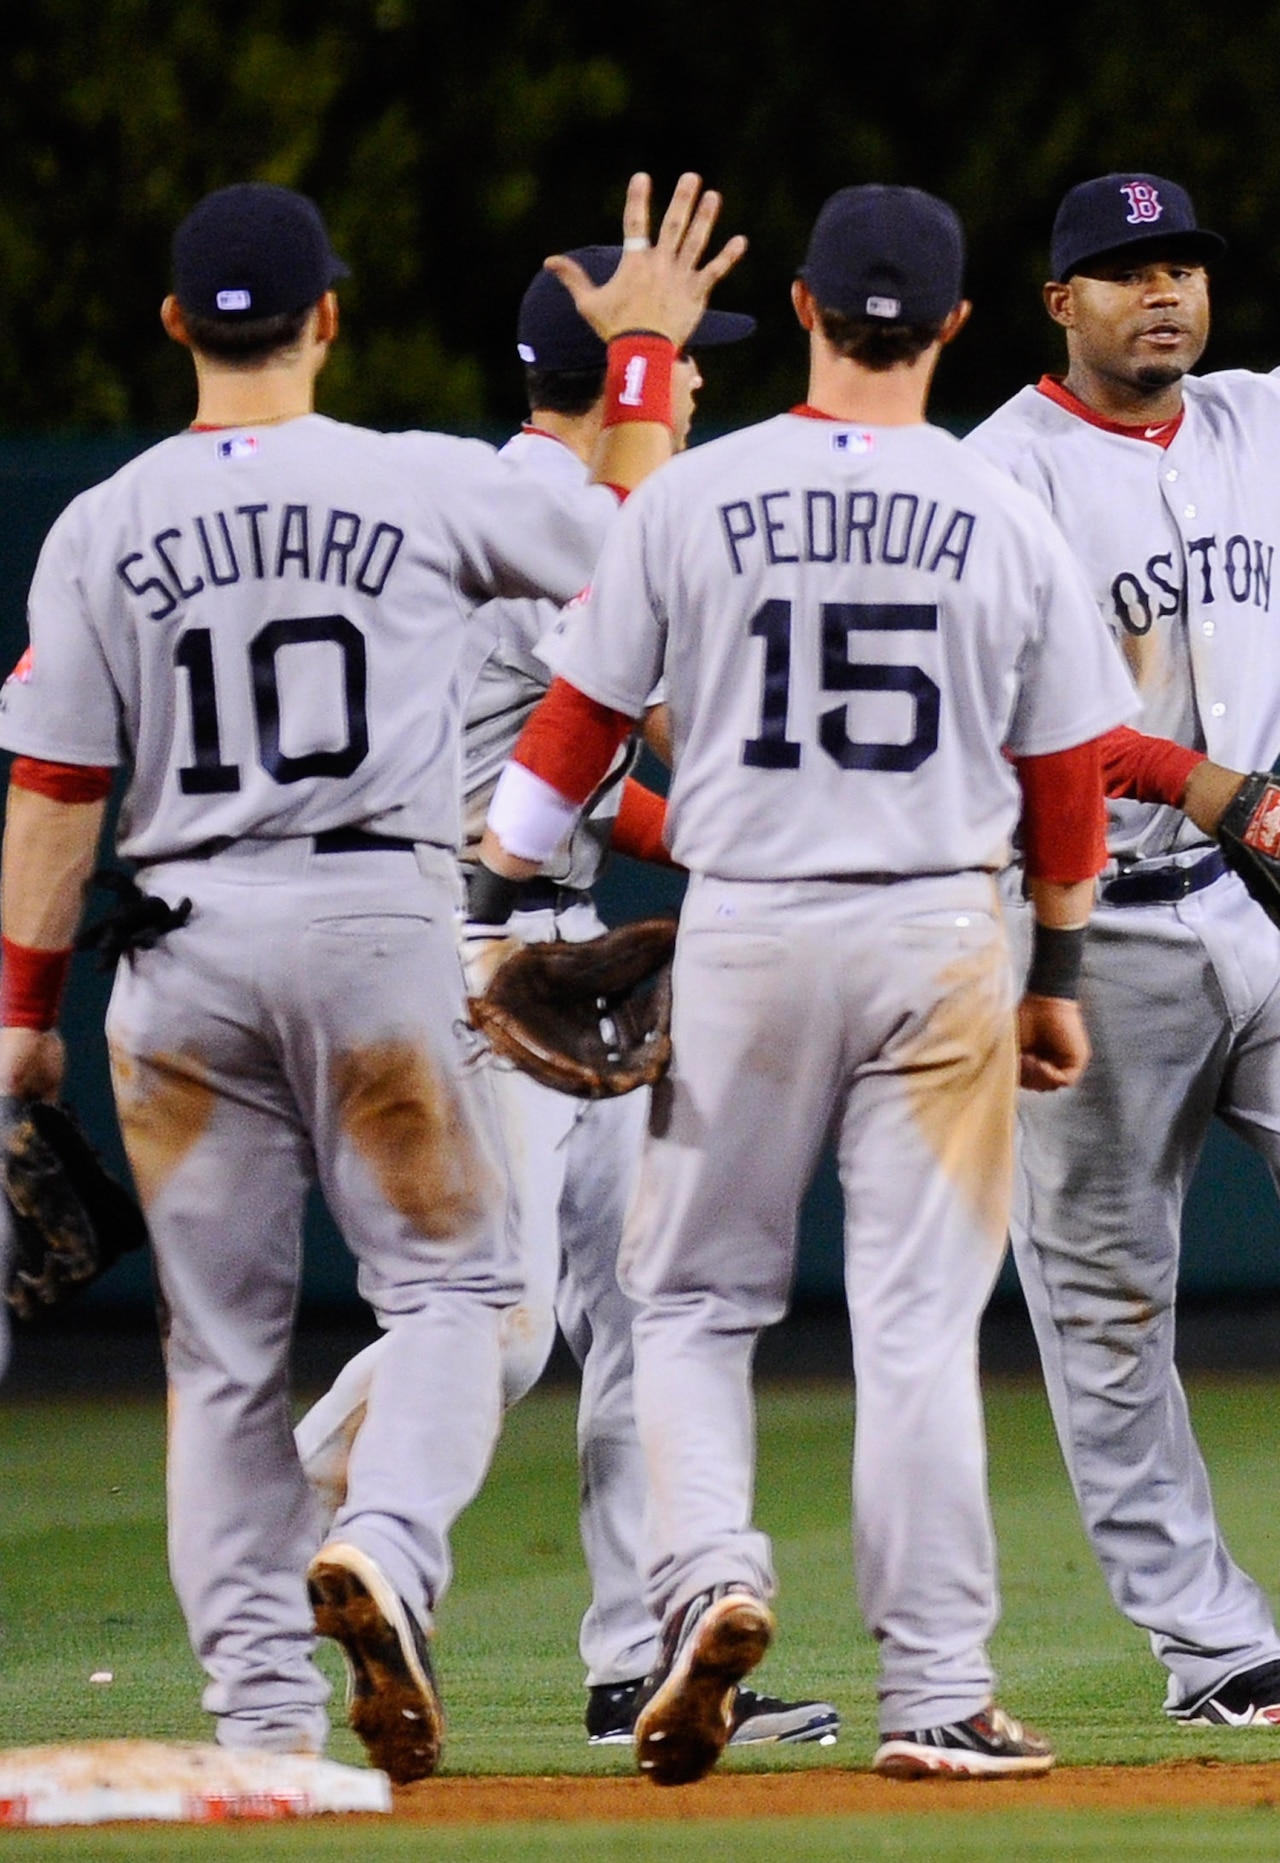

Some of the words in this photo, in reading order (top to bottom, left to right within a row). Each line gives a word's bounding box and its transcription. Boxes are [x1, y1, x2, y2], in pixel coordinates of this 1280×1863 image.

[1120, 182, 1163, 224] B
[619, 355, 647, 406] 1
[117, 503, 404, 622] SCUTARO
[719, 490, 977, 581] PEDROIA
[1108, 534, 1274, 637] OSTON
[175, 614, 367, 794] 10
[741, 599, 941, 772] 15
